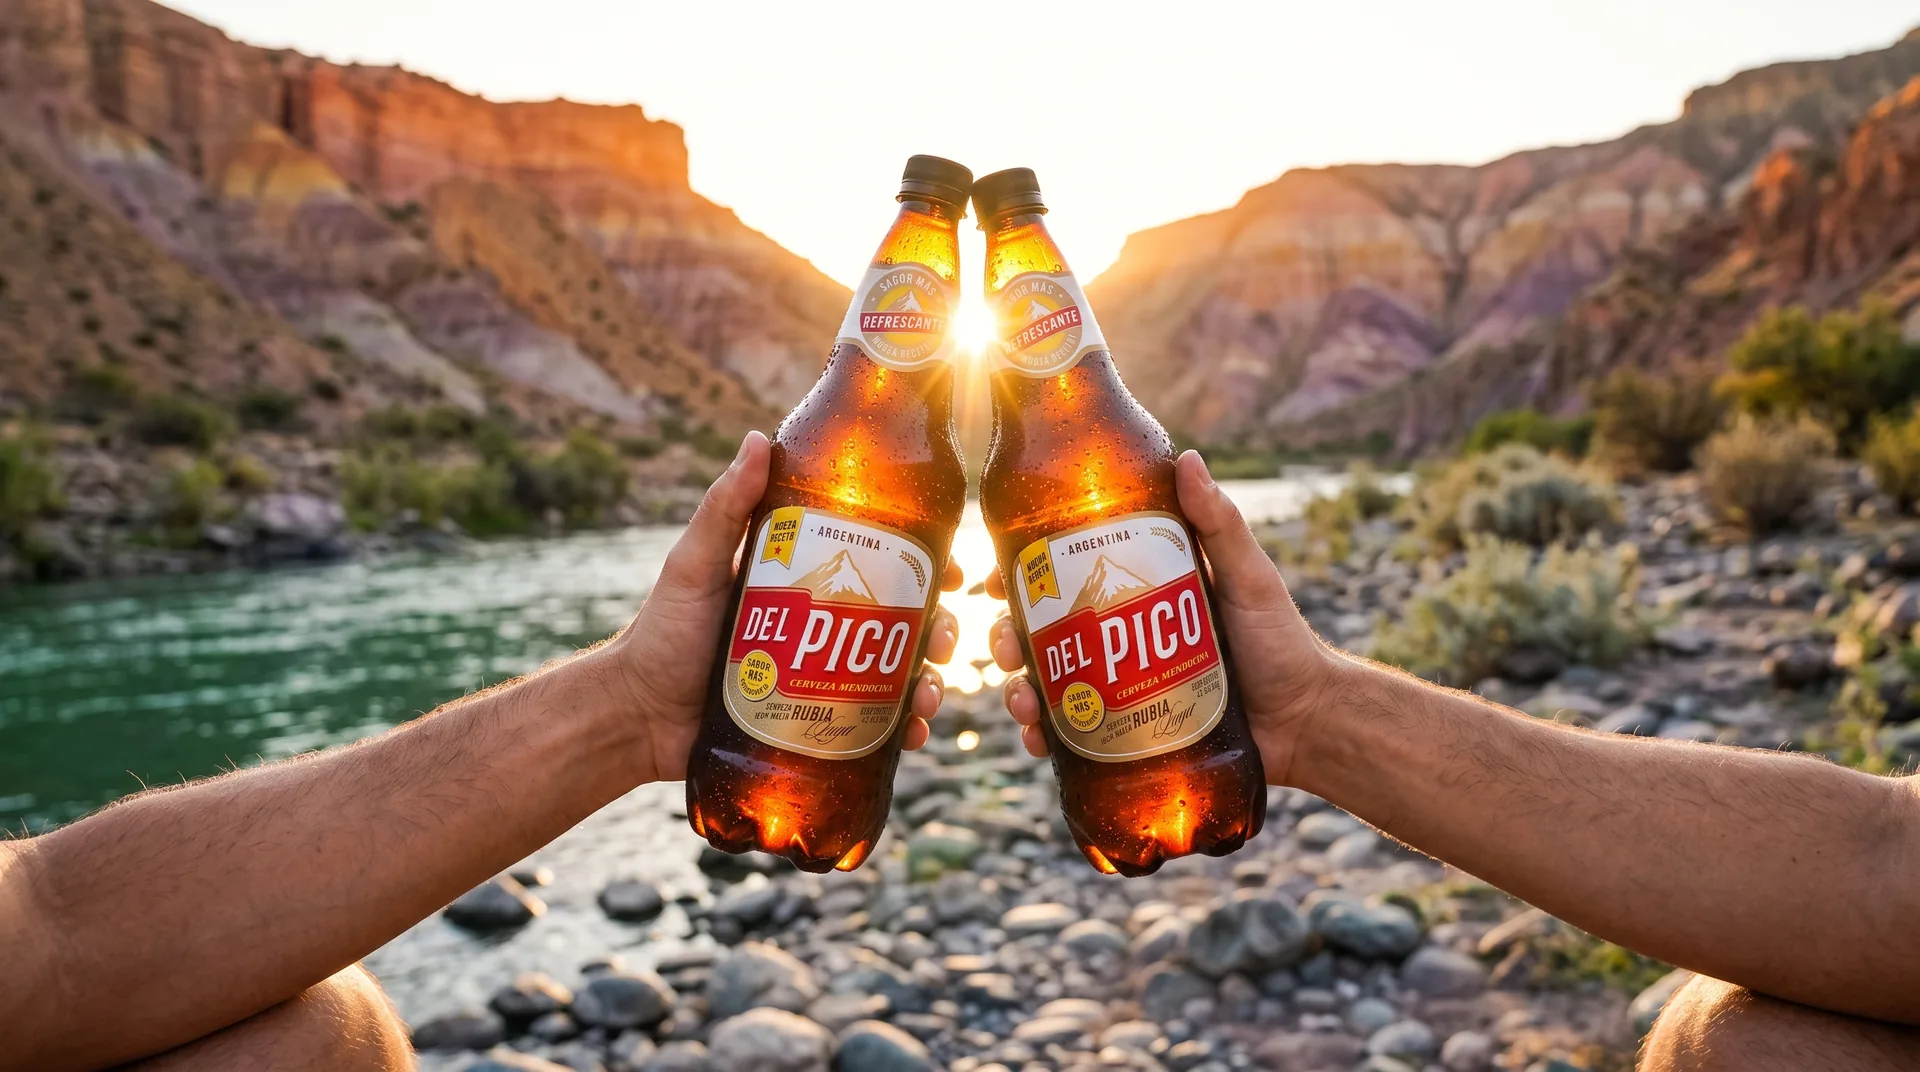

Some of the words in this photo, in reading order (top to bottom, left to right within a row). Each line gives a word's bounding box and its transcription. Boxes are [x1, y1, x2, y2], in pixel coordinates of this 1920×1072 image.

[863, 315, 944, 332] REFRESCANTE
[1005, 309, 1079, 354] REFRESCANTE
[817, 525, 881, 551] ARGENTINA
[1068, 529, 1131, 556] ARGENTINA
[742, 607, 790, 642] DEL
[790, 609, 910, 675] PICO
[1046, 631, 1092, 683] DEL
[1100, 589, 1201, 685] PICO
[746, 658, 771, 672] SABOR
[1116, 676, 1160, 700] CERVEZA
[1161, 651, 1210, 681] MENDOCINA
[789, 678, 836, 691] CERVEZA
[838, 681, 893, 693] MENDOCINA
[1067, 690, 1092, 703] SABOR
[790, 705, 834, 722] RUBIA
[1133, 698, 1171, 730] RUBIA
